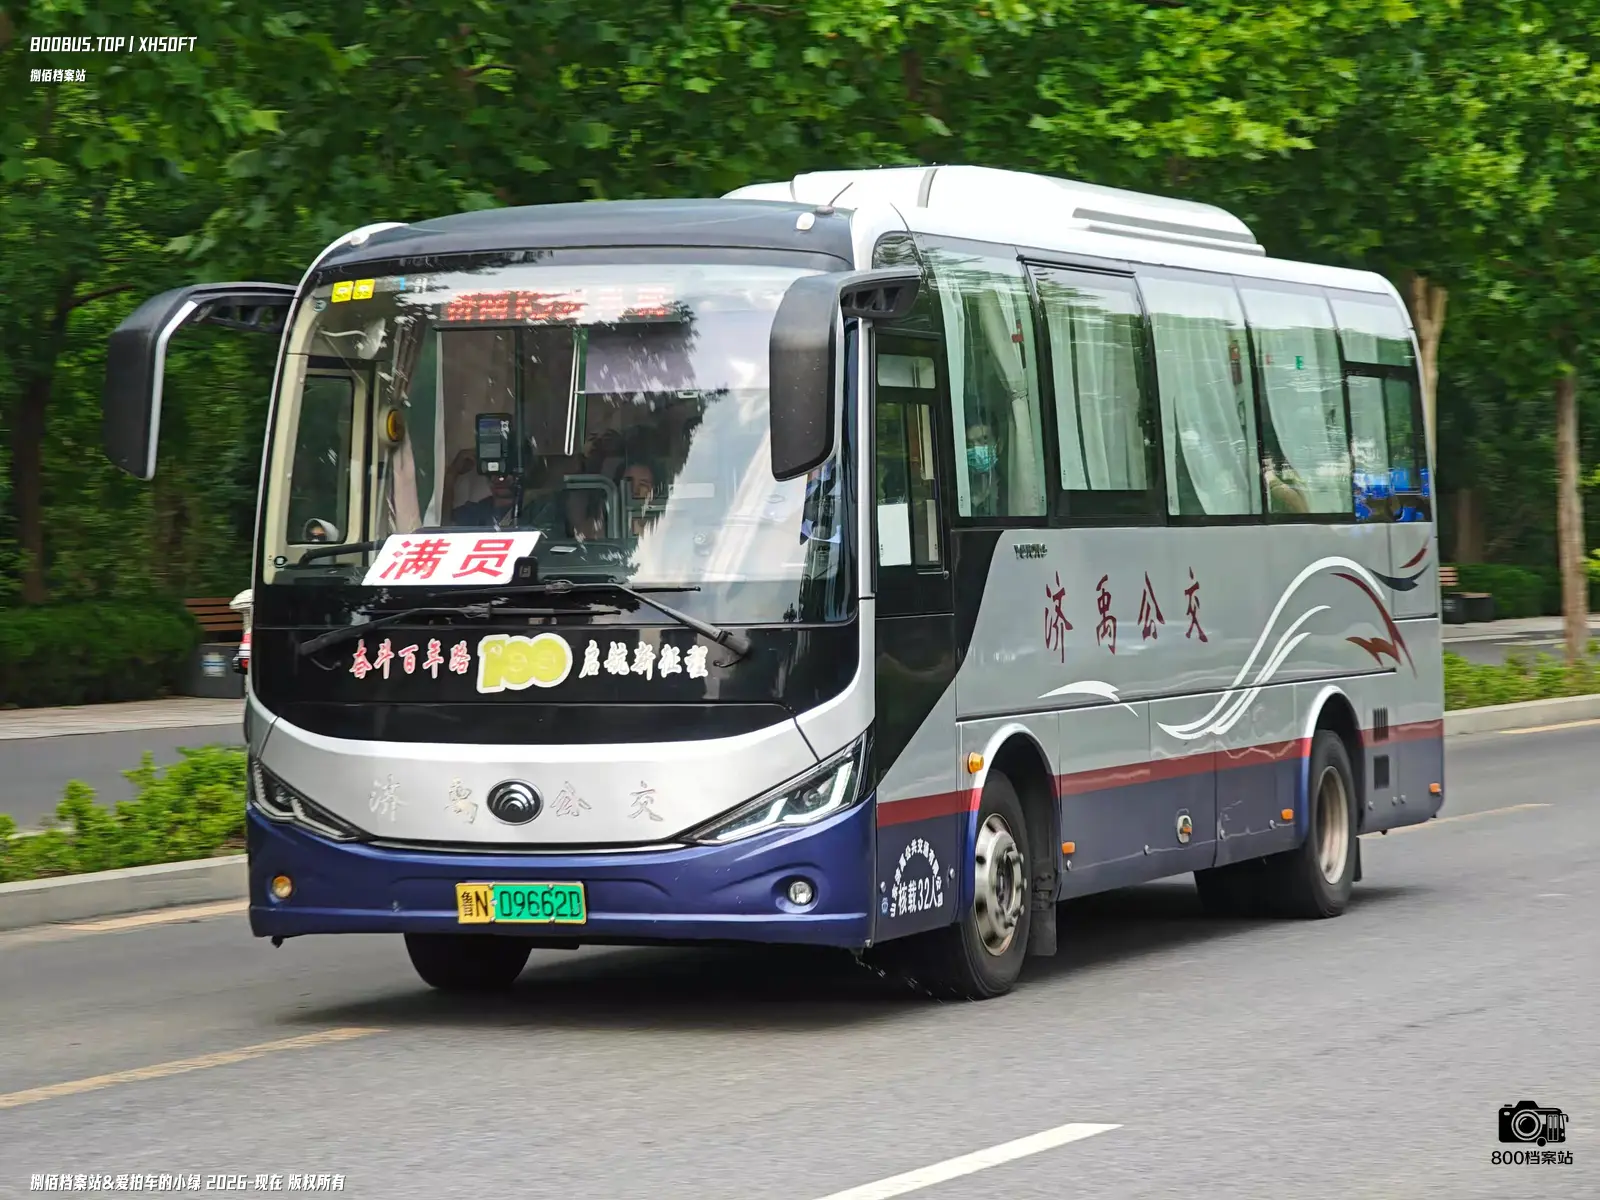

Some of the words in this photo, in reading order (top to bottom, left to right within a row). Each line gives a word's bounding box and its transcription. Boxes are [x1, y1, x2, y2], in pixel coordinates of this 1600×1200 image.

[379, 538, 515, 580] 满员
[1044, 565, 1209, 664] 济禹公交
[349, 638, 472, 680] 奋斗百年路
[897, 875, 939, 916] 核载32人
